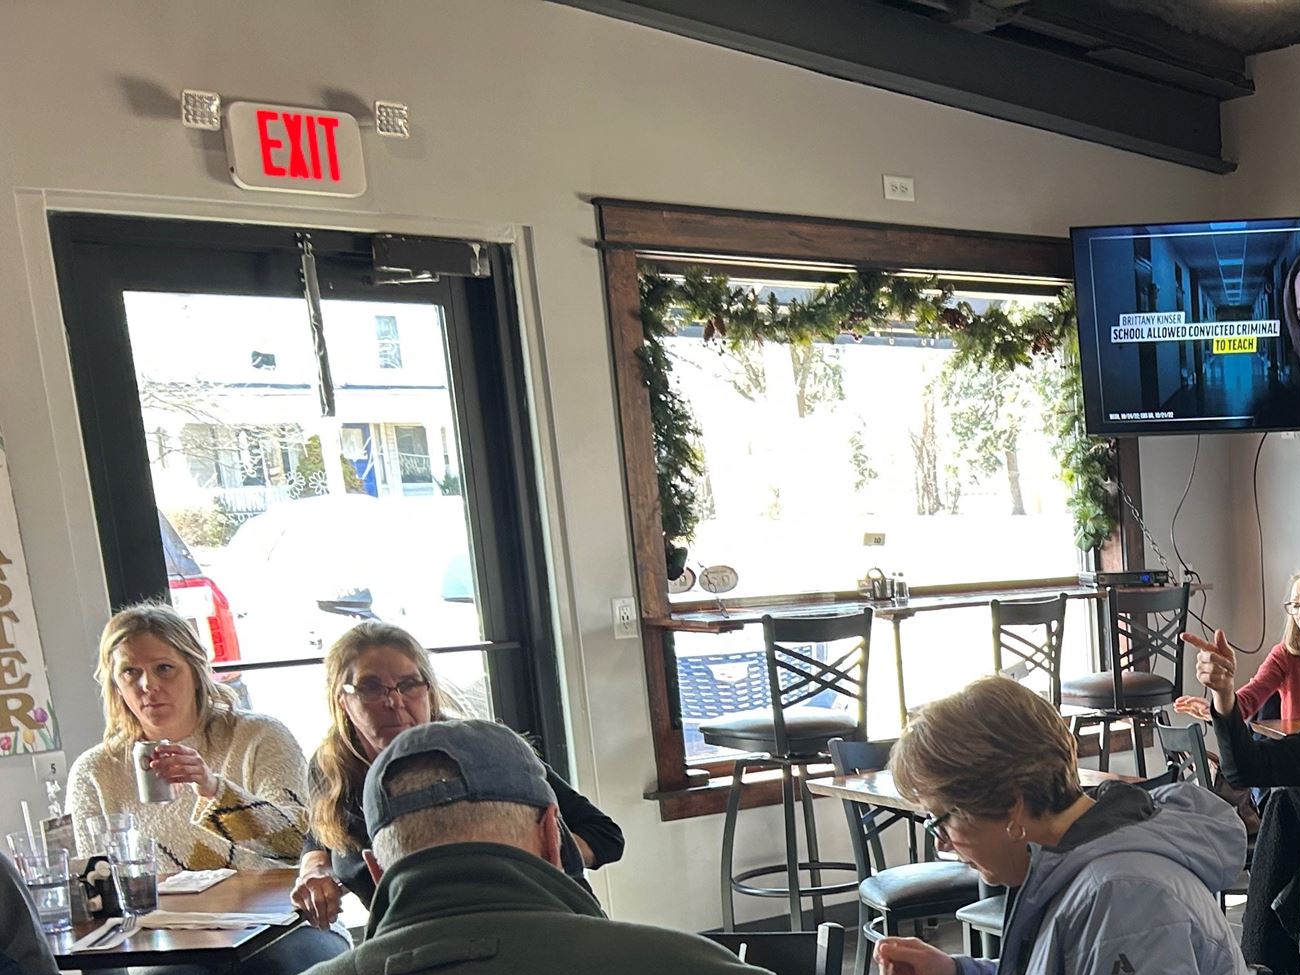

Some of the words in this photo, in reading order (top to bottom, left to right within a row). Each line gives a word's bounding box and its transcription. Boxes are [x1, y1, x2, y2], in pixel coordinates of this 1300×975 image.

[256, 110, 341, 181] EXIT
[1122, 315, 1154, 326] BRITTANY
[1157, 313, 1182, 324] KINSER
[1113, 328, 1145, 340] SCHOOL
[1147, 326, 1186, 339] ALLOWED
[1188, 324, 1235, 337] CONVICTED
[1236, 322, 1278, 336] CRIMINAL
[1215, 340, 1226, 351] TO
[1227, 338, 1254, 350] TEACH
